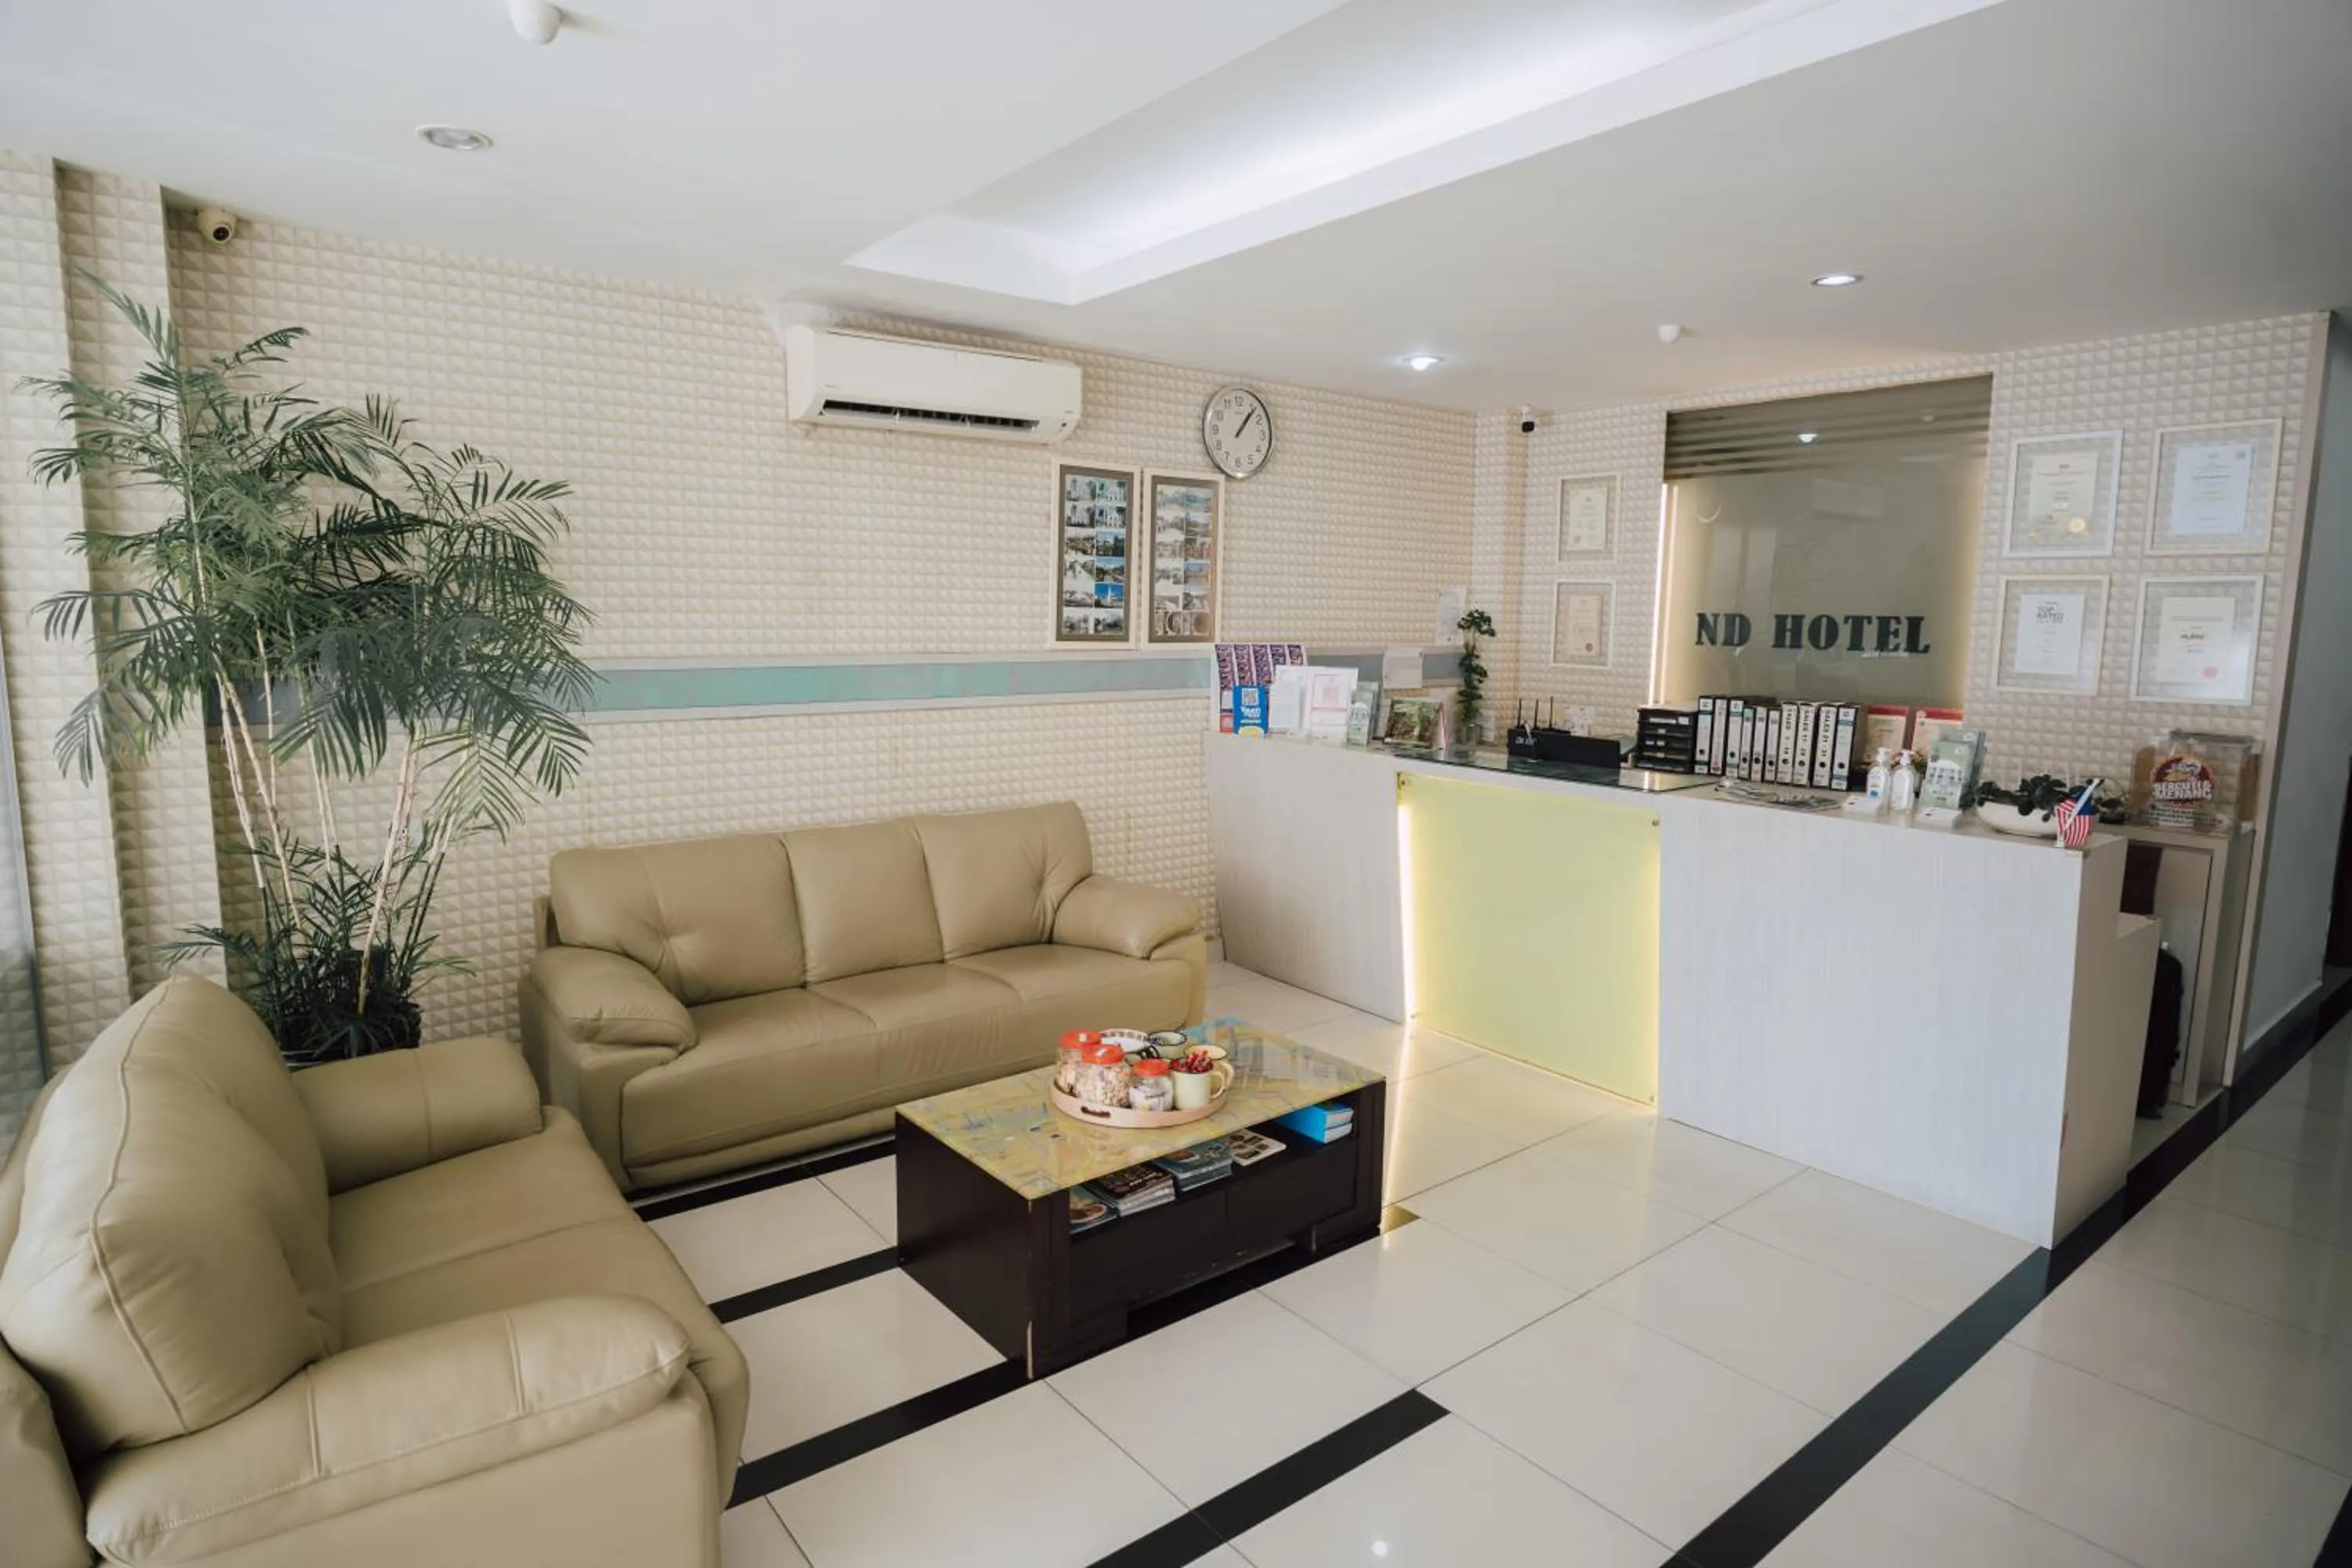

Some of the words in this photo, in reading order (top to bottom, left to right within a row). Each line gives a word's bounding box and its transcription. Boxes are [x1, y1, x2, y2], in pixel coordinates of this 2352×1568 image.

[1224, 397, 1231, 408] 11
[1234, 394, 1244, 406] 12
[1215, 410, 1224, 421] 10
[1255, 414, 1263, 425] 2
[1212, 424, 1219, 435] 9
[1260, 429, 1266, 441] 3
[1215, 440, 1222, 451] 8
[1224, 451, 1230, 461] 7
[1247, 455, 1254, 465] 5
[1235, 457, 1241, 468] 6
[1695, 612, 1751, 647] ND
[1772, 614, 1931, 653] HOTEL
